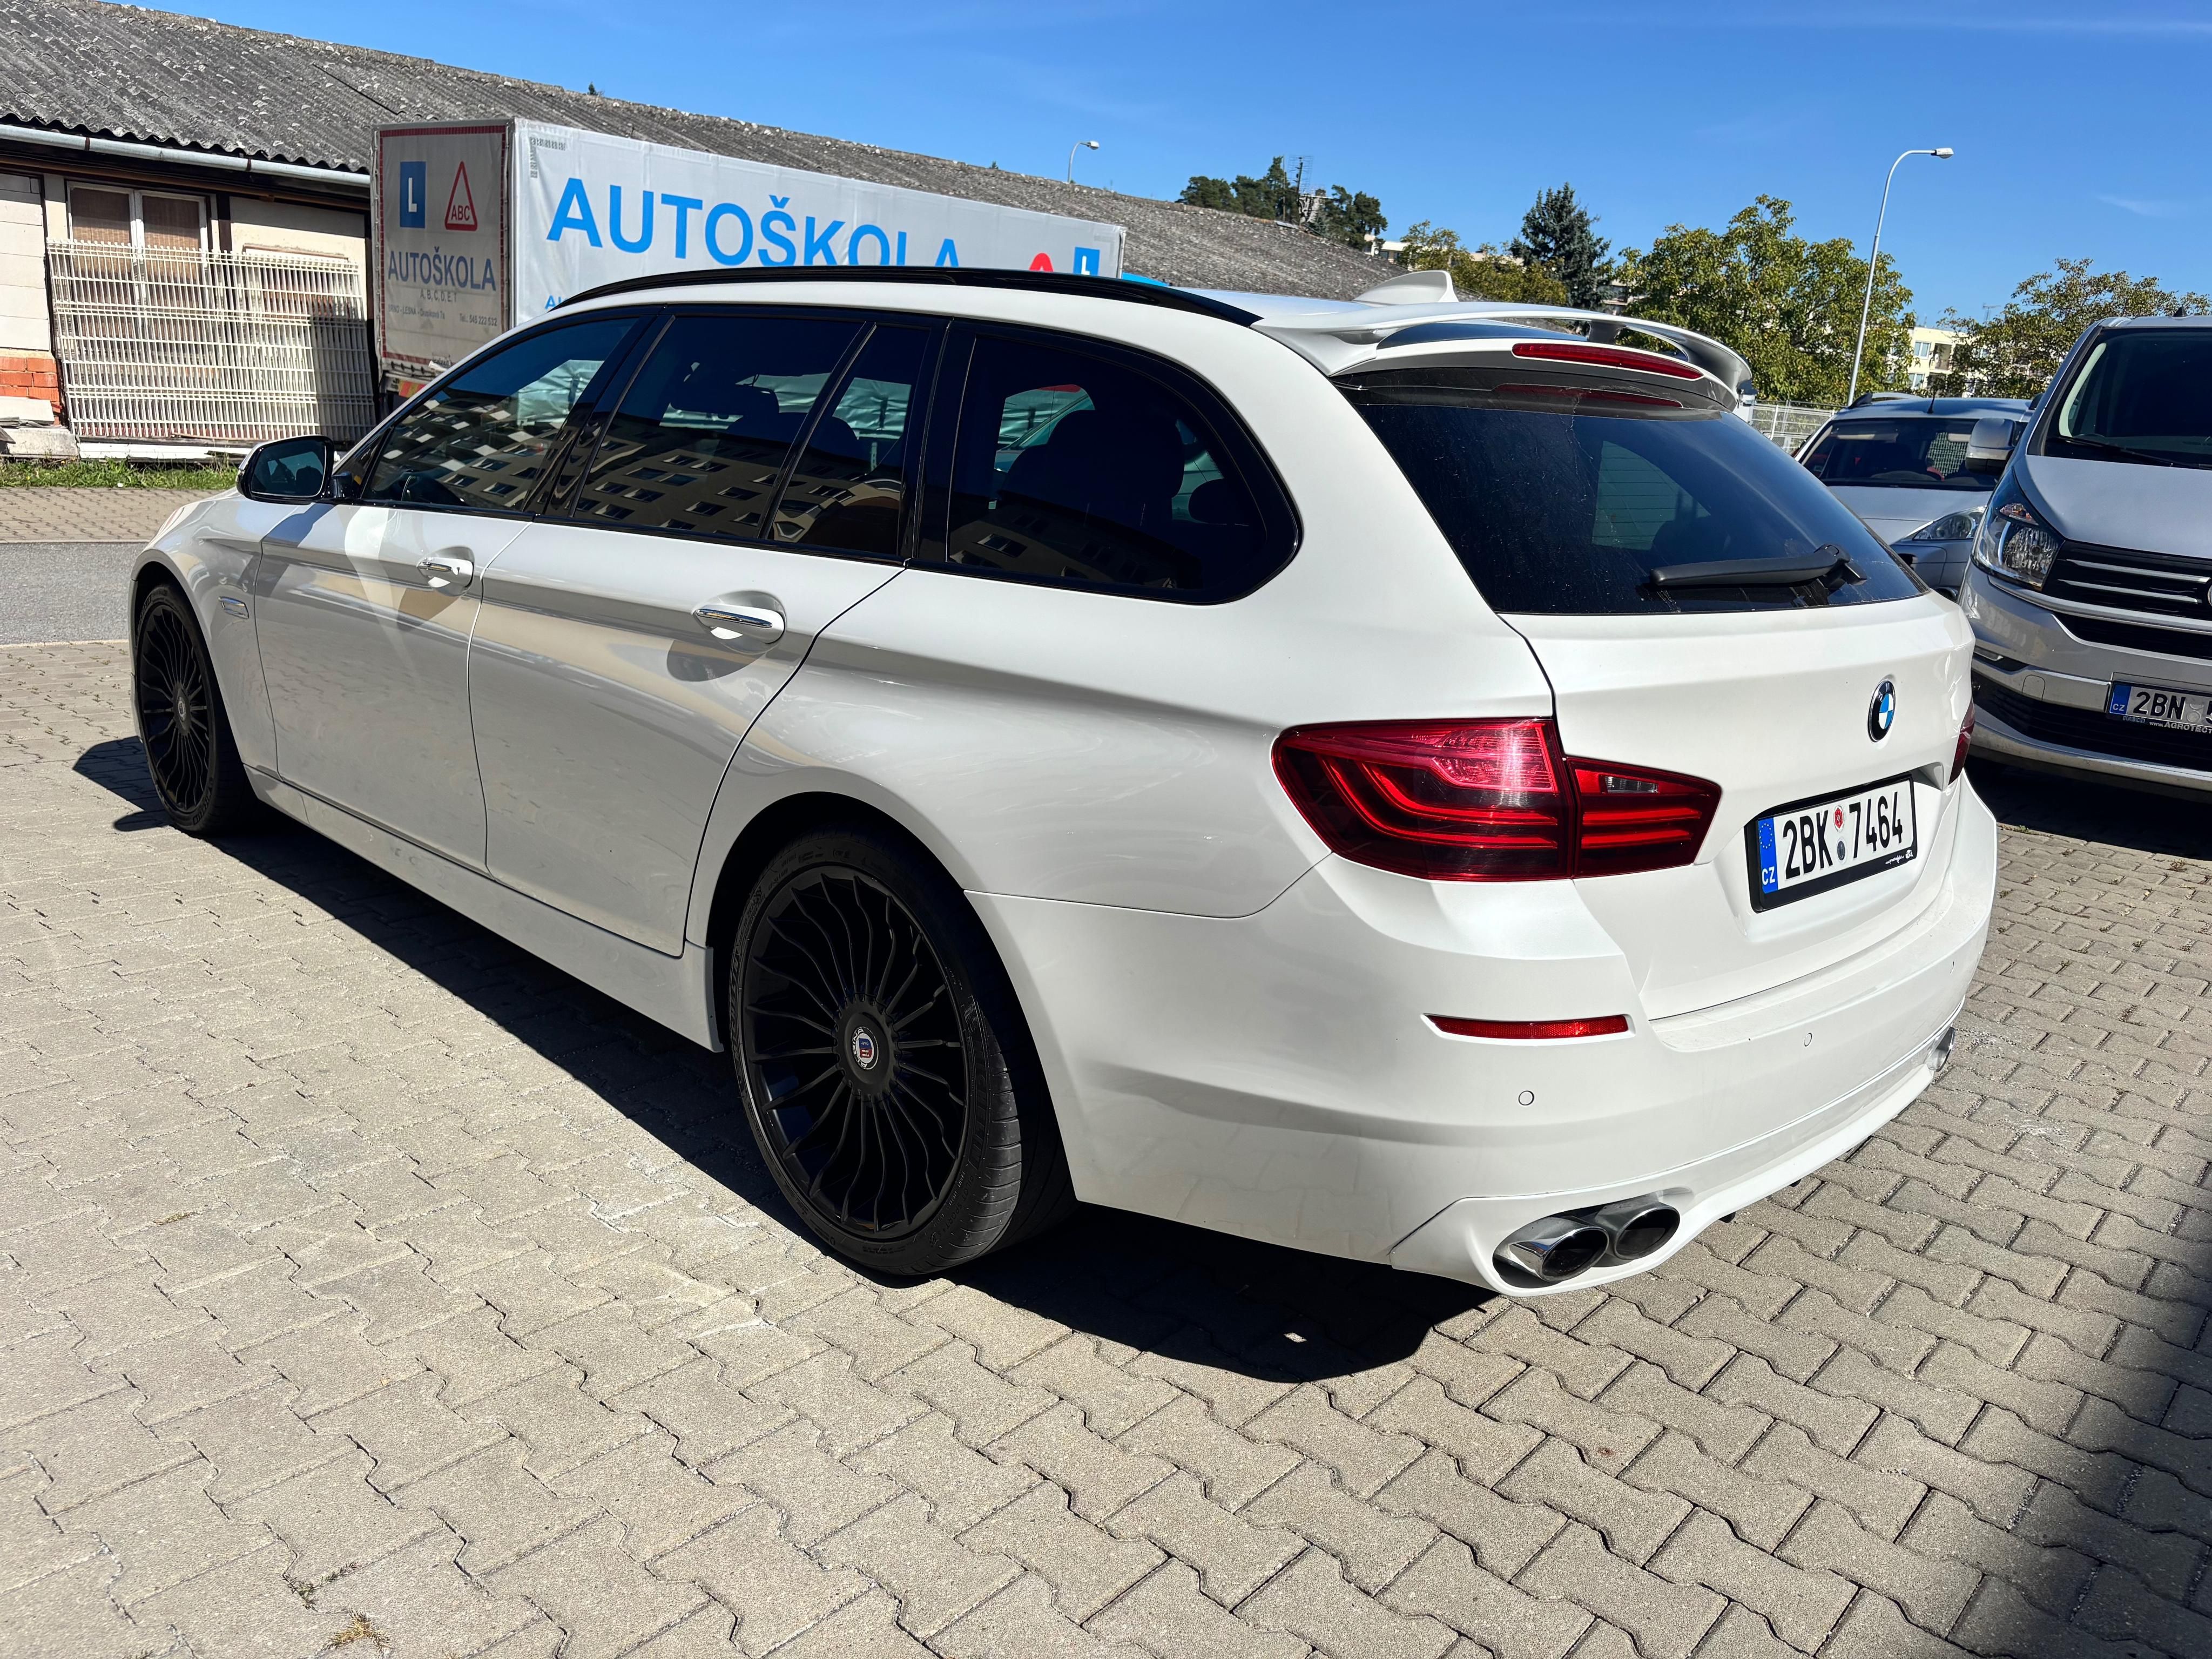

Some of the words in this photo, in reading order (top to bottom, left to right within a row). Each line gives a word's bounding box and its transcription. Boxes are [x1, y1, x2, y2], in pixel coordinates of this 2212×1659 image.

[408, 178, 417, 212] L
[451, 205, 470, 221] ABC
[547, 178, 959, 266] AUTOŠKOLA
[388, 246, 496, 291] AUTOŠKOLA
[2133, 692, 2186, 720] 2BN
[1783, 810, 1833, 879] 2BK
[1849, 791, 1903, 859] 7464
[1762, 866, 1776, 885] CZ
